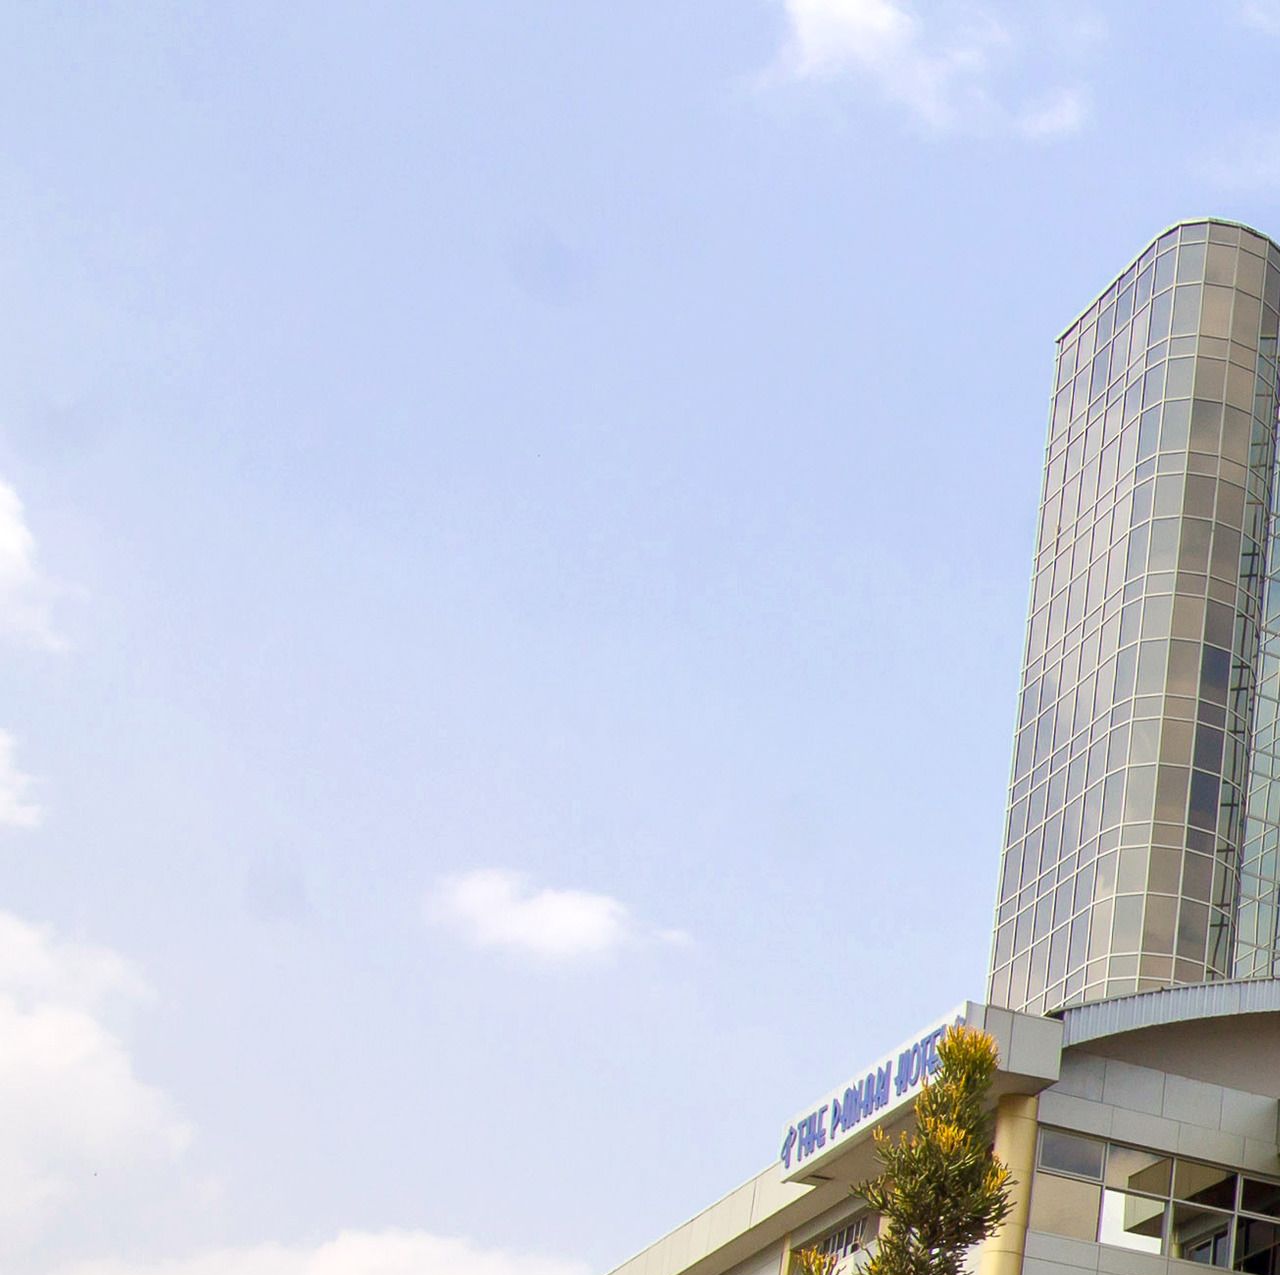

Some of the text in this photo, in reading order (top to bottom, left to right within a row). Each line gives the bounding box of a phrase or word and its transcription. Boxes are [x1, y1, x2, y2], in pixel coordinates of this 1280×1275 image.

[797, 1023, 946, 1162] THE PANARI HOTE
